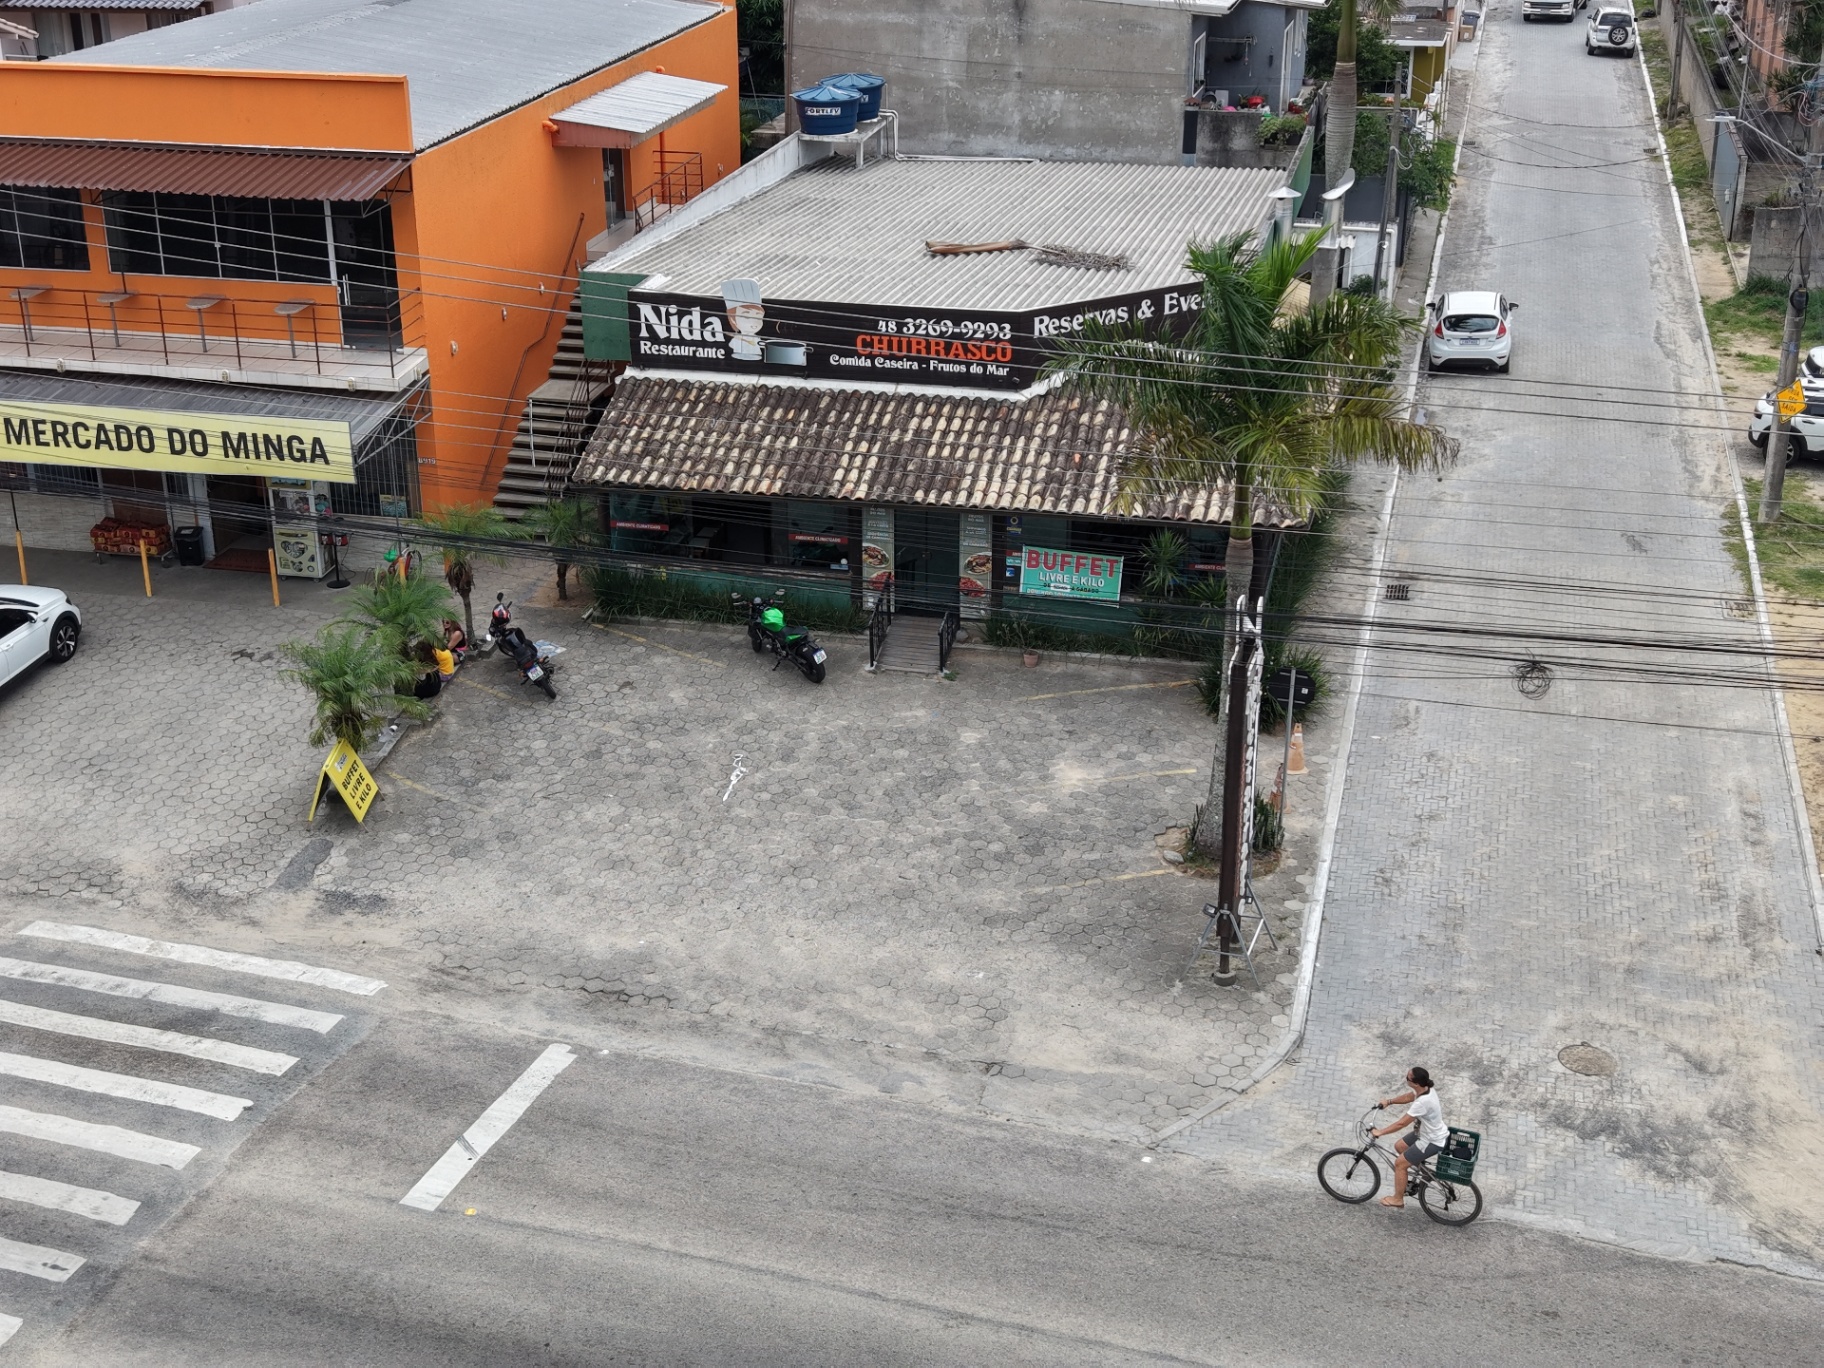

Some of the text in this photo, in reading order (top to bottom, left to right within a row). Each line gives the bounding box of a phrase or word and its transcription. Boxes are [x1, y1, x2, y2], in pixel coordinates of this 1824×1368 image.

[637, 304, 726, 342] Nida
[878, 318, 1012, 340] 48 3269-9293
[1034, 306, 1129, 339] Reservas
[1137, 298, 1155, 319] &
[640, 340, 726, 359] Restaurante
[856, 334, 1012, 362] CHURRASCO
[829, 354, 872, 367] Comida
[874, 356, 919, 370] Caseira
[930, 360, 967, 372] Frutos
[970, 362, 984, 374] do
[986, 364, 1010, 376] Mar
[3, 417, 330, 466] MERCADO DO MINGA
[1026, 549, 1119, 578] BUFFET
[1039, 571, 1070, 584] LIVRE
[1072, 574, 1079, 585] E
[1080, 576, 1105, 588] KILO
[342, 760, 359, 790] BUFFET
[350, 773, 365, 799] LIVRE
[356, 783, 371, 810] E KILO
